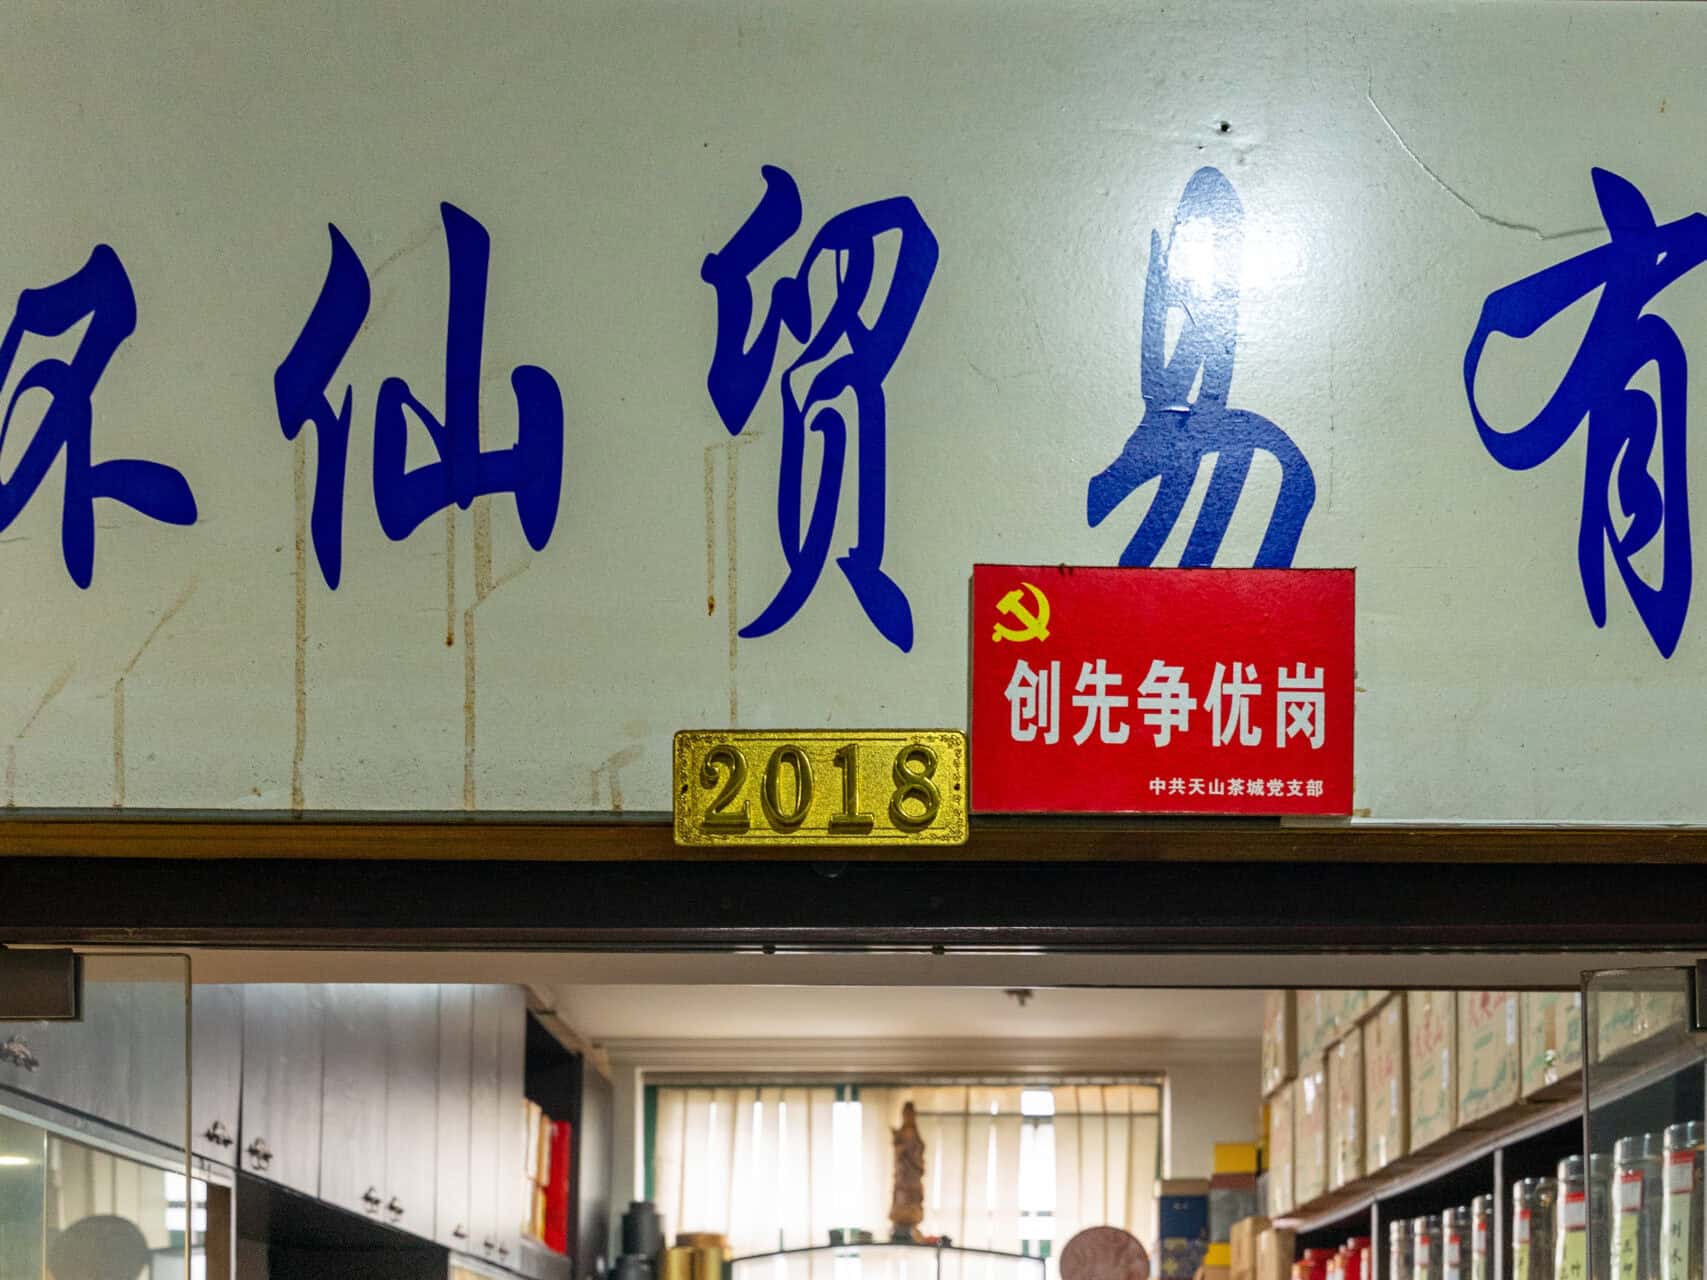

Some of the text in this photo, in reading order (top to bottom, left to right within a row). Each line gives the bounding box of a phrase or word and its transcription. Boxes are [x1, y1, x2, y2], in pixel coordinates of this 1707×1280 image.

[1004, 658, 1326, 749] 创先争优岗
[701, 743, 941, 835] 2018
[1149, 777, 1324, 798] 中共天山茶城党支部
